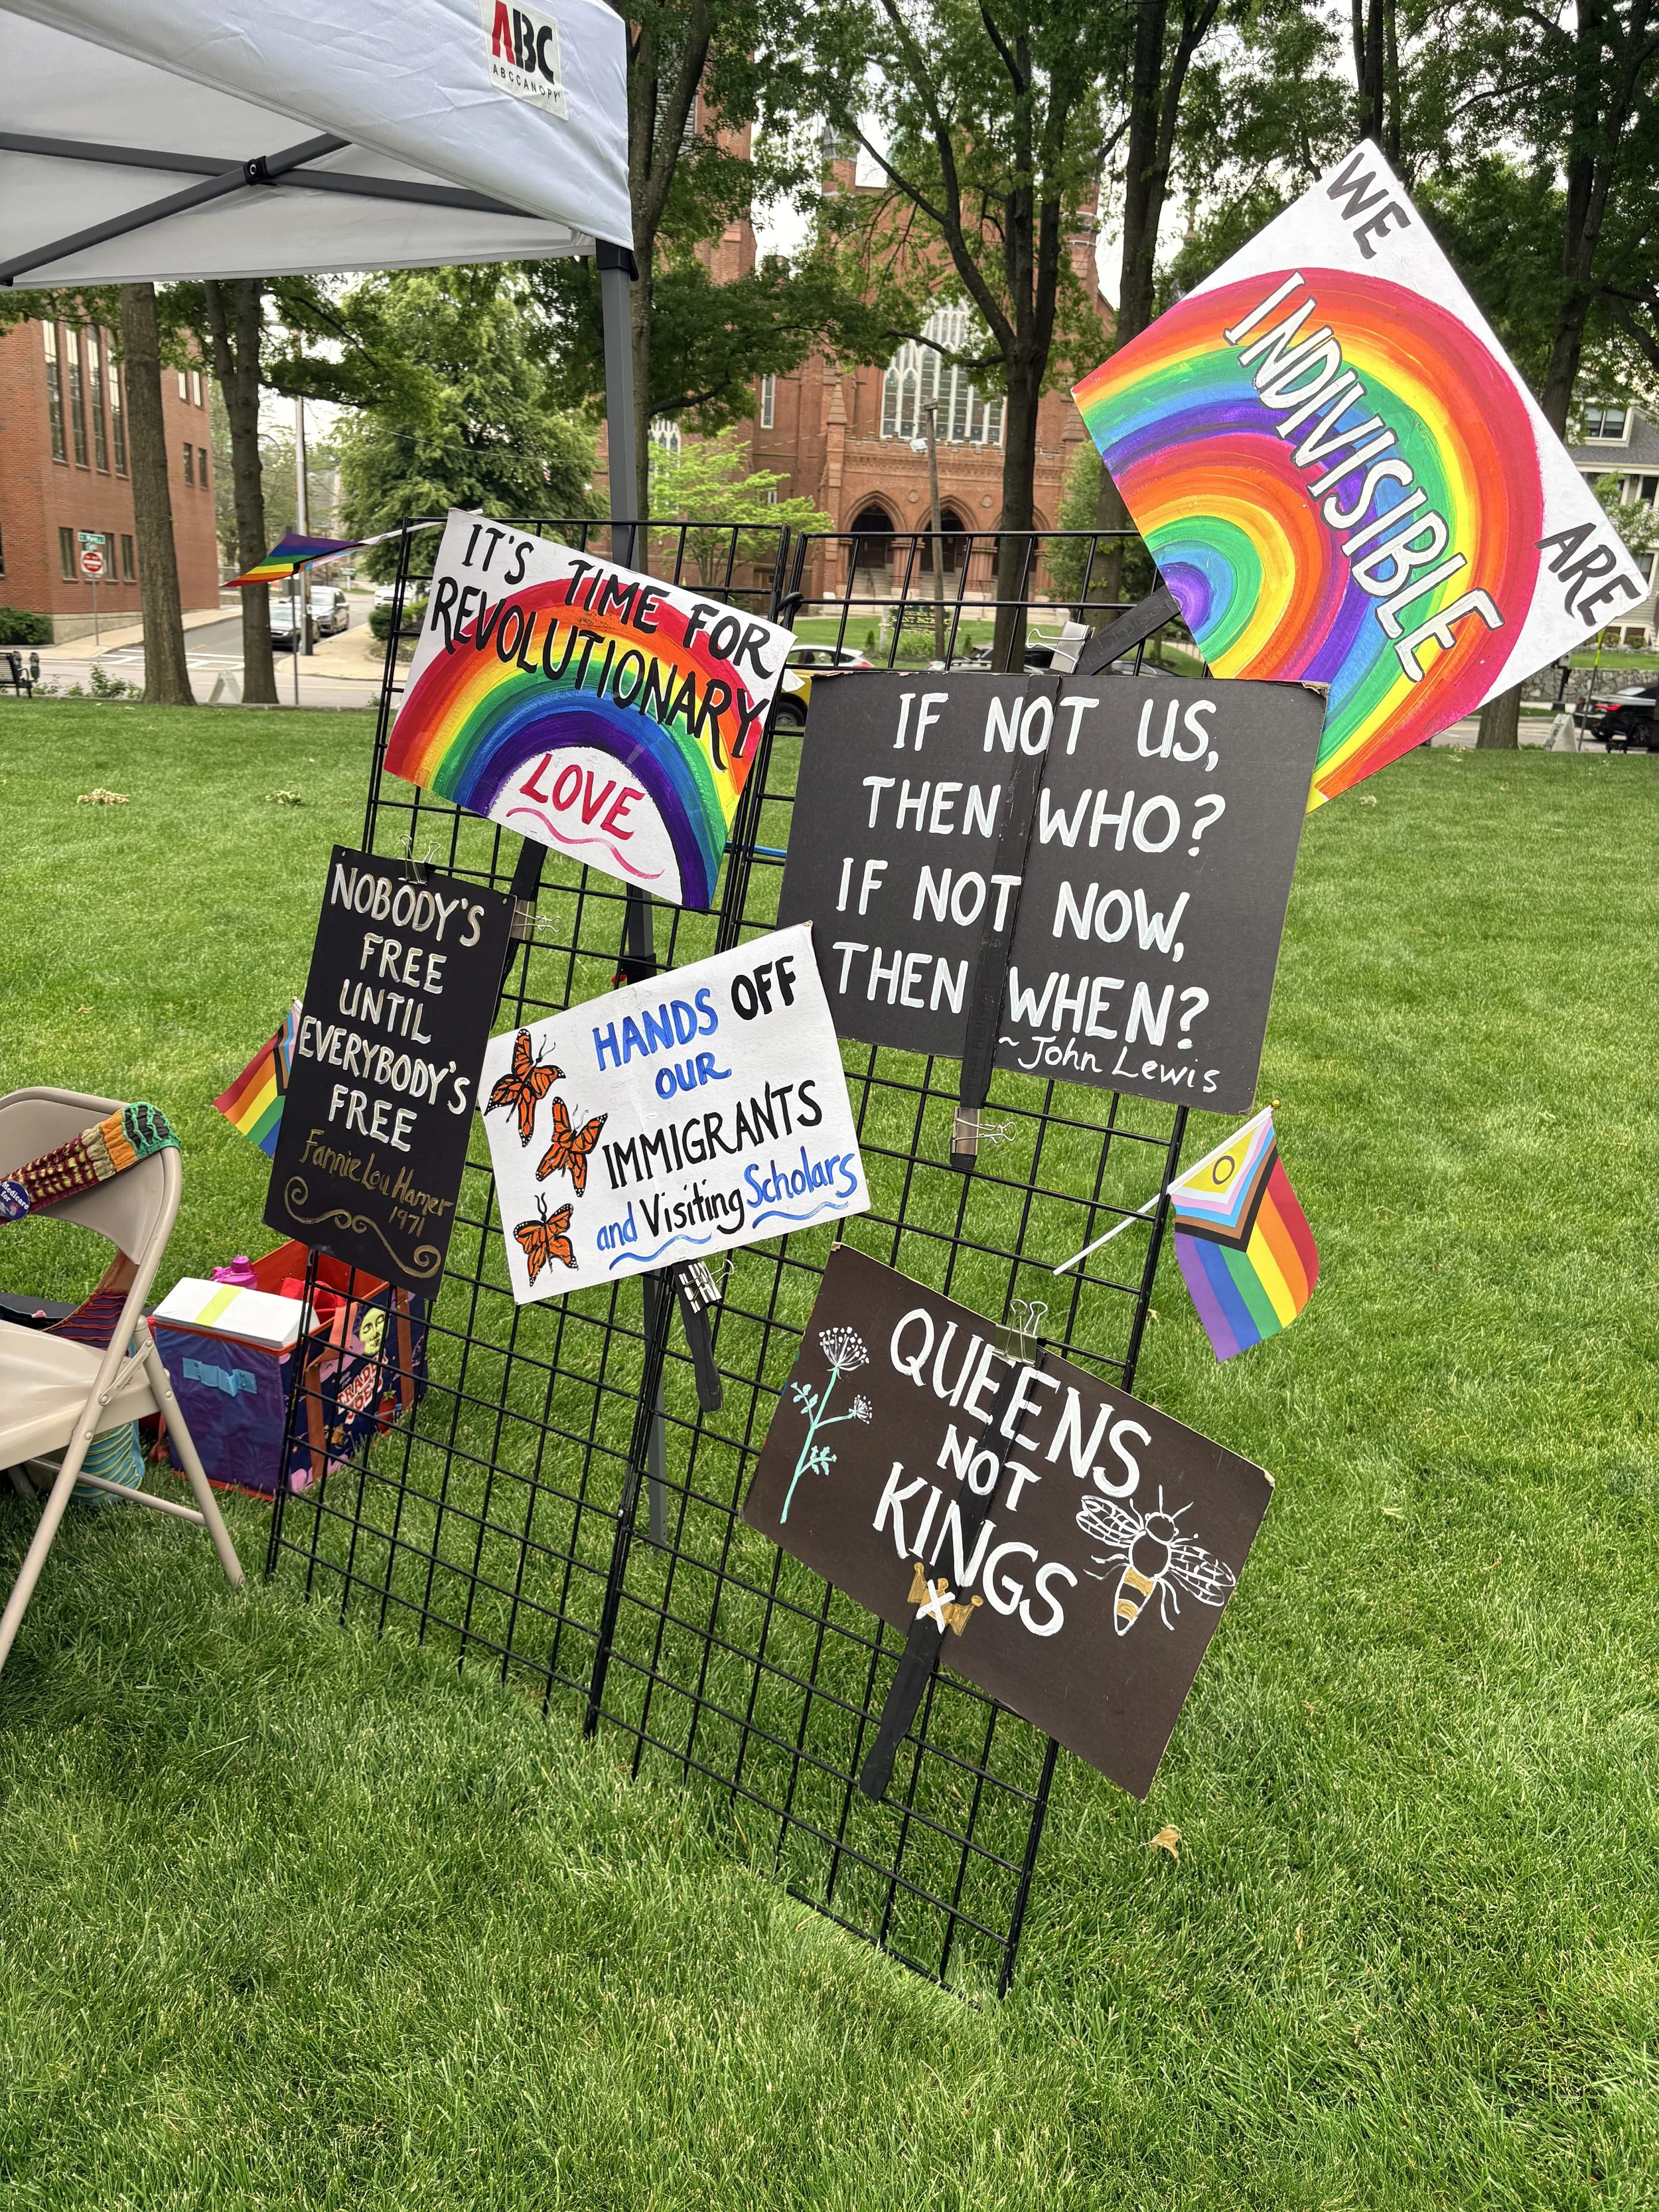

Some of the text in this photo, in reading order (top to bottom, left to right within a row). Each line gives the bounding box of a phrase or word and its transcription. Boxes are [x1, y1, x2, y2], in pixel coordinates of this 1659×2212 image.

[492, 0, 555, 85] ABC
[1327, 152, 1643, 627] WE ARE
[1223, 270, 1504, 683] INDIVISIBLE
[463, 524, 773, 679] IT'S TIME FOR
[431, 577, 770, 773] REVOLUTIONARY
[893, 692, 1220, 772] IF NOT US,
[520, 753, 646, 840] LOVE
[862, 776, 1226, 857] THEN WHO?
[330, 863, 484, 947] NOBODY'S
[836, 857, 1190, 963] IF NOT NOW,
[360, 932, 447, 994] FREE
[832, 941, 1210, 1051] THEN WHEN?
[340, 979, 432, 1044] UNTIL
[592, 955, 796, 1071] HANDS OFF
[298, 1015, 470, 1115] EVERYBODY'S
[654, 1052, 732, 1099] OUR
[1112, 1050, 1220, 1093] Lewis
[328, 1084, 417, 1151] FREE
[602, 1080, 823, 1190] IMMIGRANTS
[1, 1181, 29, 1210] Medicare
[1, 1191, 11, 1202] for
[300, 1128, 455, 1217] Fannie Lou Hamer
[597, 1146, 857, 1251] and Visiting Scholars
[389, 1205, 425, 1237] 1971
[889, 1308, 1151, 1499] QUEENS
[936, 1424, 1042, 1511] NOT
[871, 1461, 1078, 1637] KINGS
